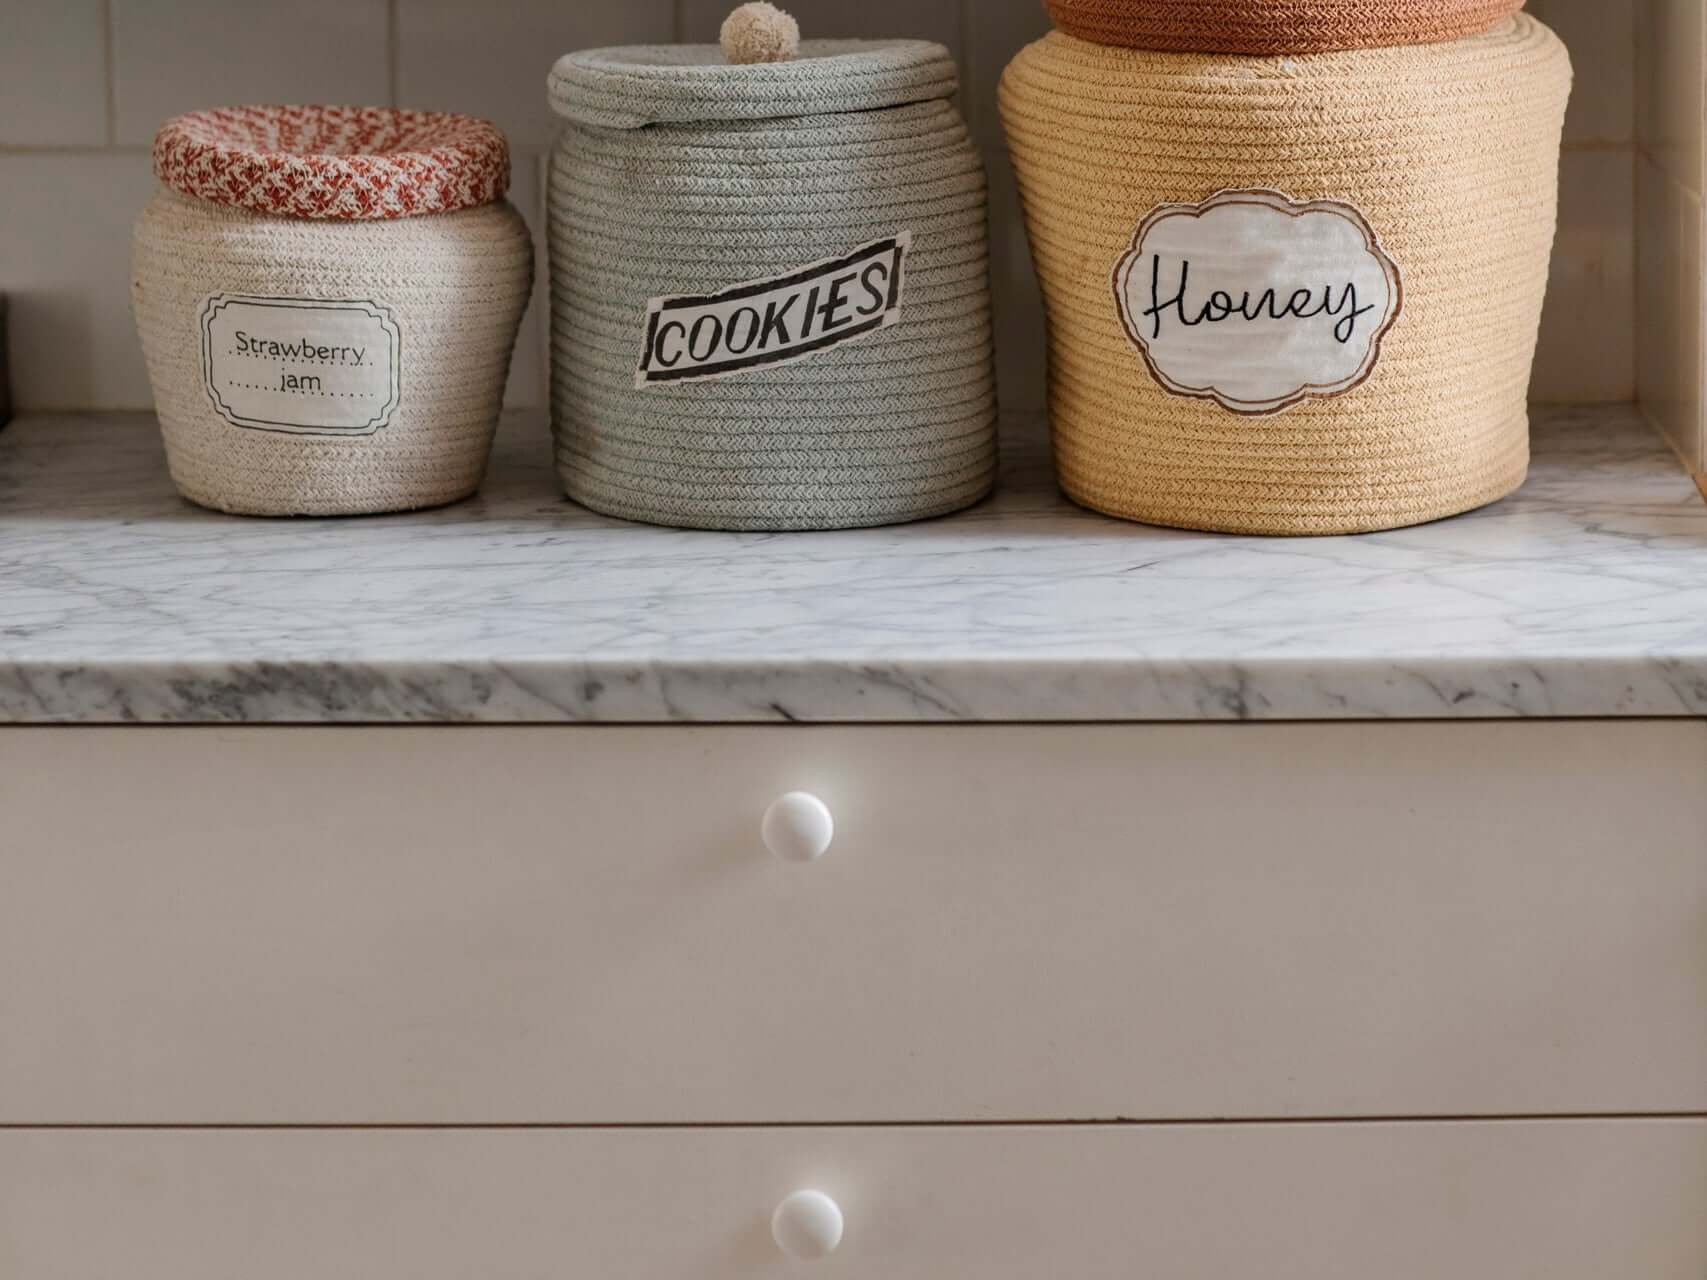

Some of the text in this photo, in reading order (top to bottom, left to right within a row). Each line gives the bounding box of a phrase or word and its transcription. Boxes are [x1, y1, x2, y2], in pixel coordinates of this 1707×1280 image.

[655, 261, 888, 367] COOKIES
[1143, 254, 1375, 343] Honey
[235, 331, 366, 366] Strawberry
[279, 367, 321, 392] jam
